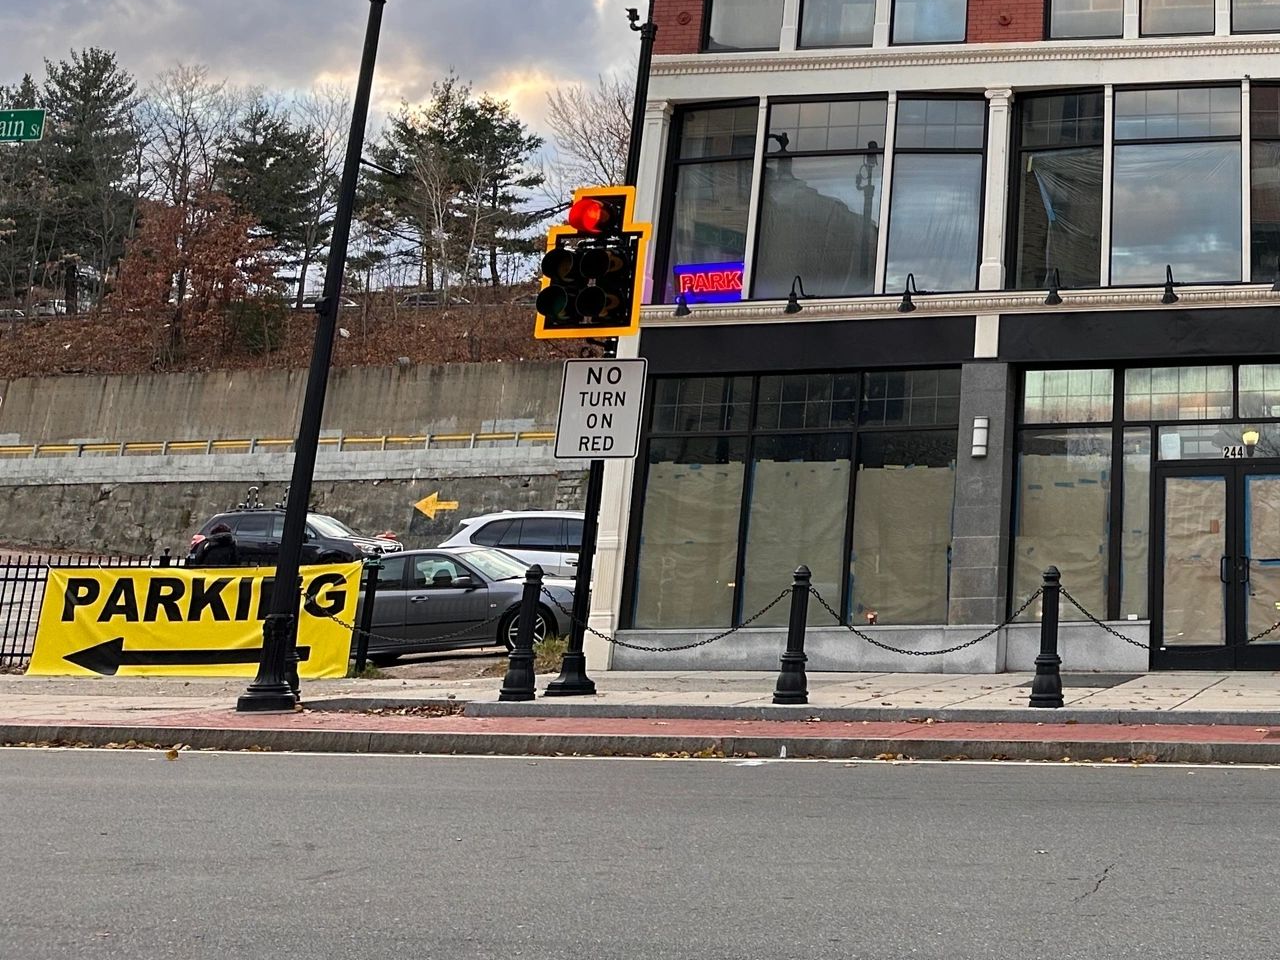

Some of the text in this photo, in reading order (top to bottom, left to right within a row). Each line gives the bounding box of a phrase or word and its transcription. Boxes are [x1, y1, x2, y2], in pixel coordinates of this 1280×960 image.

[679, 270, 743, 293] PARK
[586, 366, 622, 385] NO
[579, 391, 626, 407] TURN
[586, 413, 613, 429] ON
[578, 435, 614, 452] RED
[1223, 446, 1243, 458] 244
